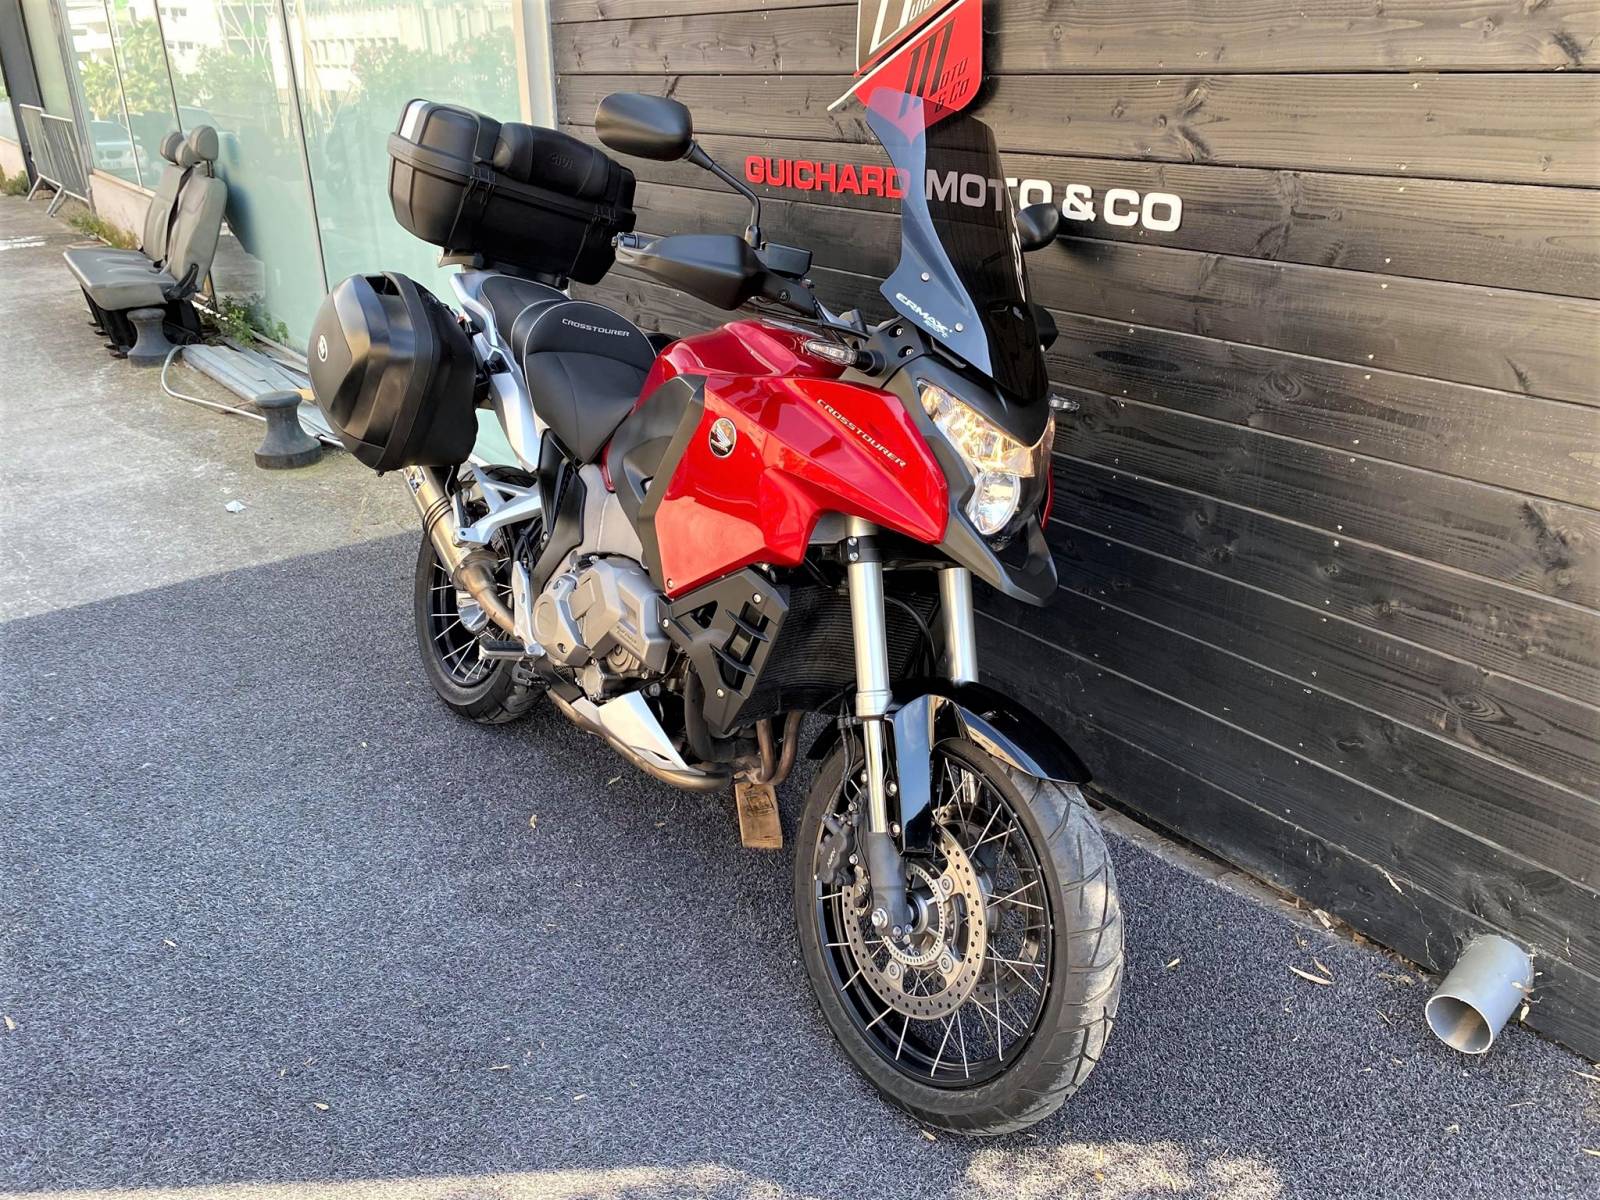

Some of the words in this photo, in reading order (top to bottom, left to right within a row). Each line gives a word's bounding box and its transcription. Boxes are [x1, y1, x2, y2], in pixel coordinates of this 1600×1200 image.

[745, 156, 910, 199] GUICHARD
[926, 168, 1053, 213] MOTO
[1062, 184, 1097, 222] &
[1103, 188, 1182, 232] CO
[562, 318, 630, 337] CROSSTOURER
[817, 399, 907, 468] CROSSTOURER
